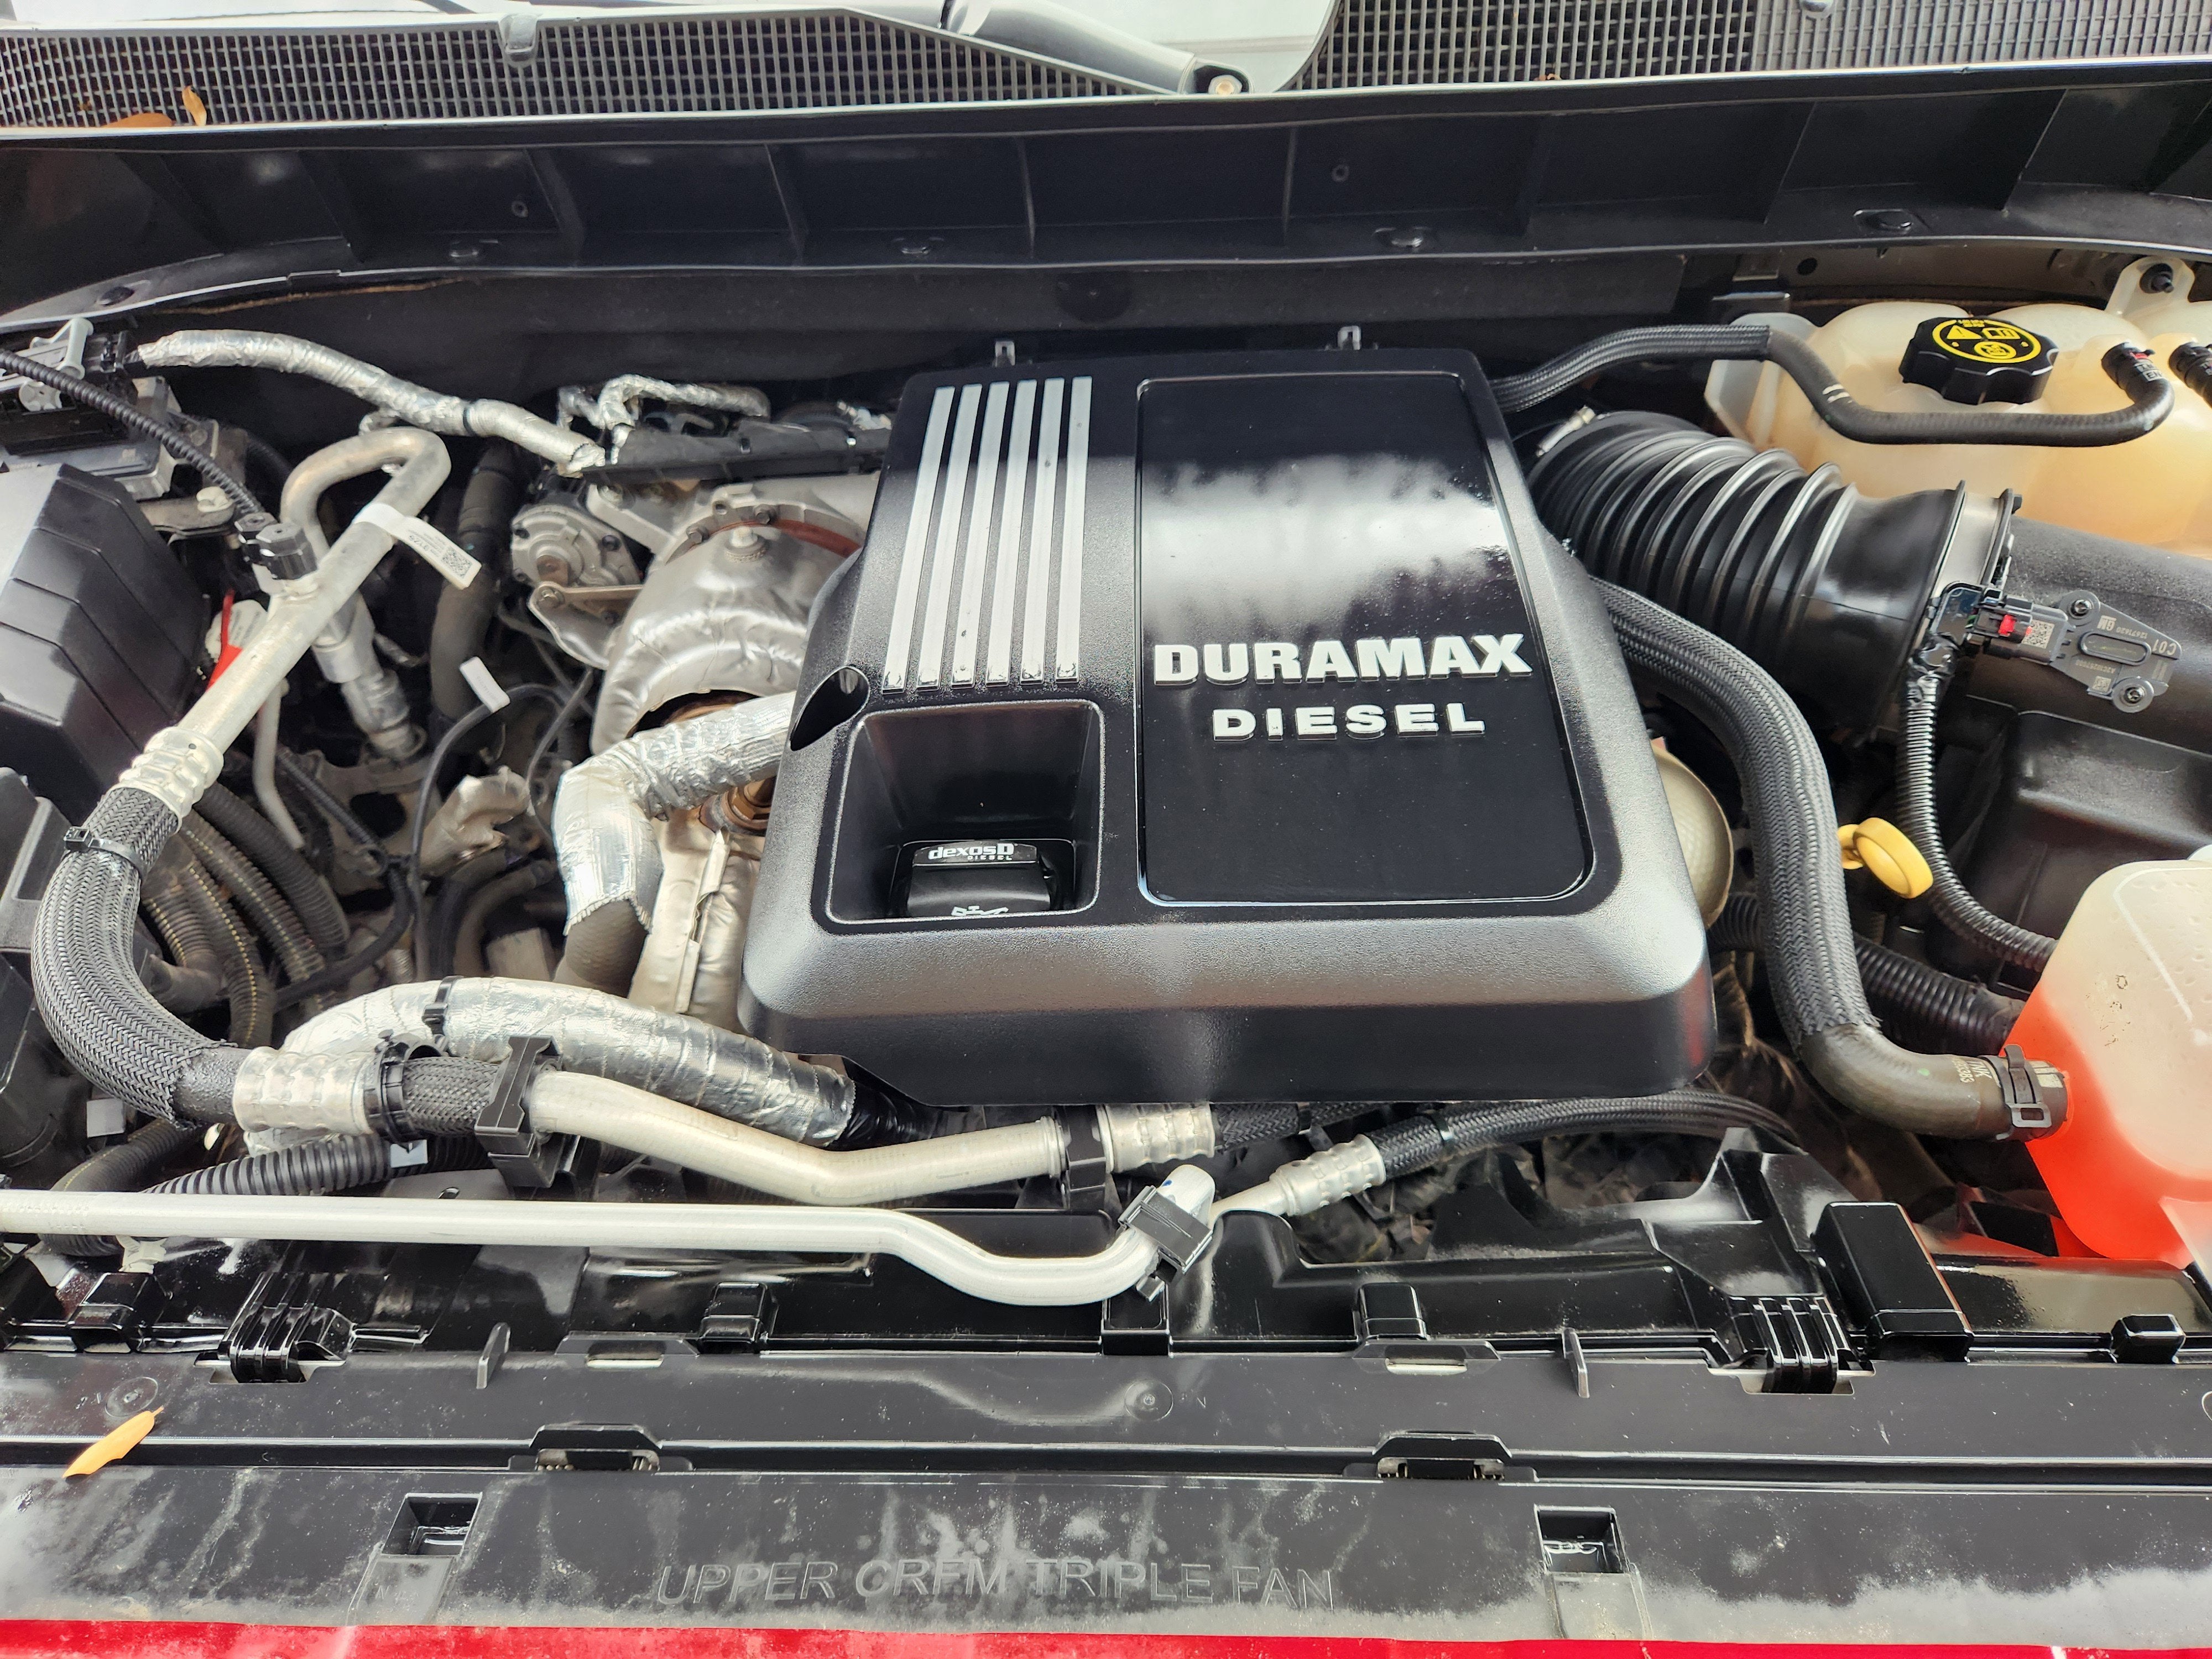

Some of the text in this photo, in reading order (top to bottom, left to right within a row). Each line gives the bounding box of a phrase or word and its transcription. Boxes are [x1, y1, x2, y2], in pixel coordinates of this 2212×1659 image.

[2097, 616, 2116, 632] GM
[1154, 634, 1532, 685] DURAMAX
[2152, 639, 2177, 656] C01
[1213, 703, 1485, 740] DIESEL
[658, 1558, 1334, 1610] UPPER CRFM TRIPLE FAN
